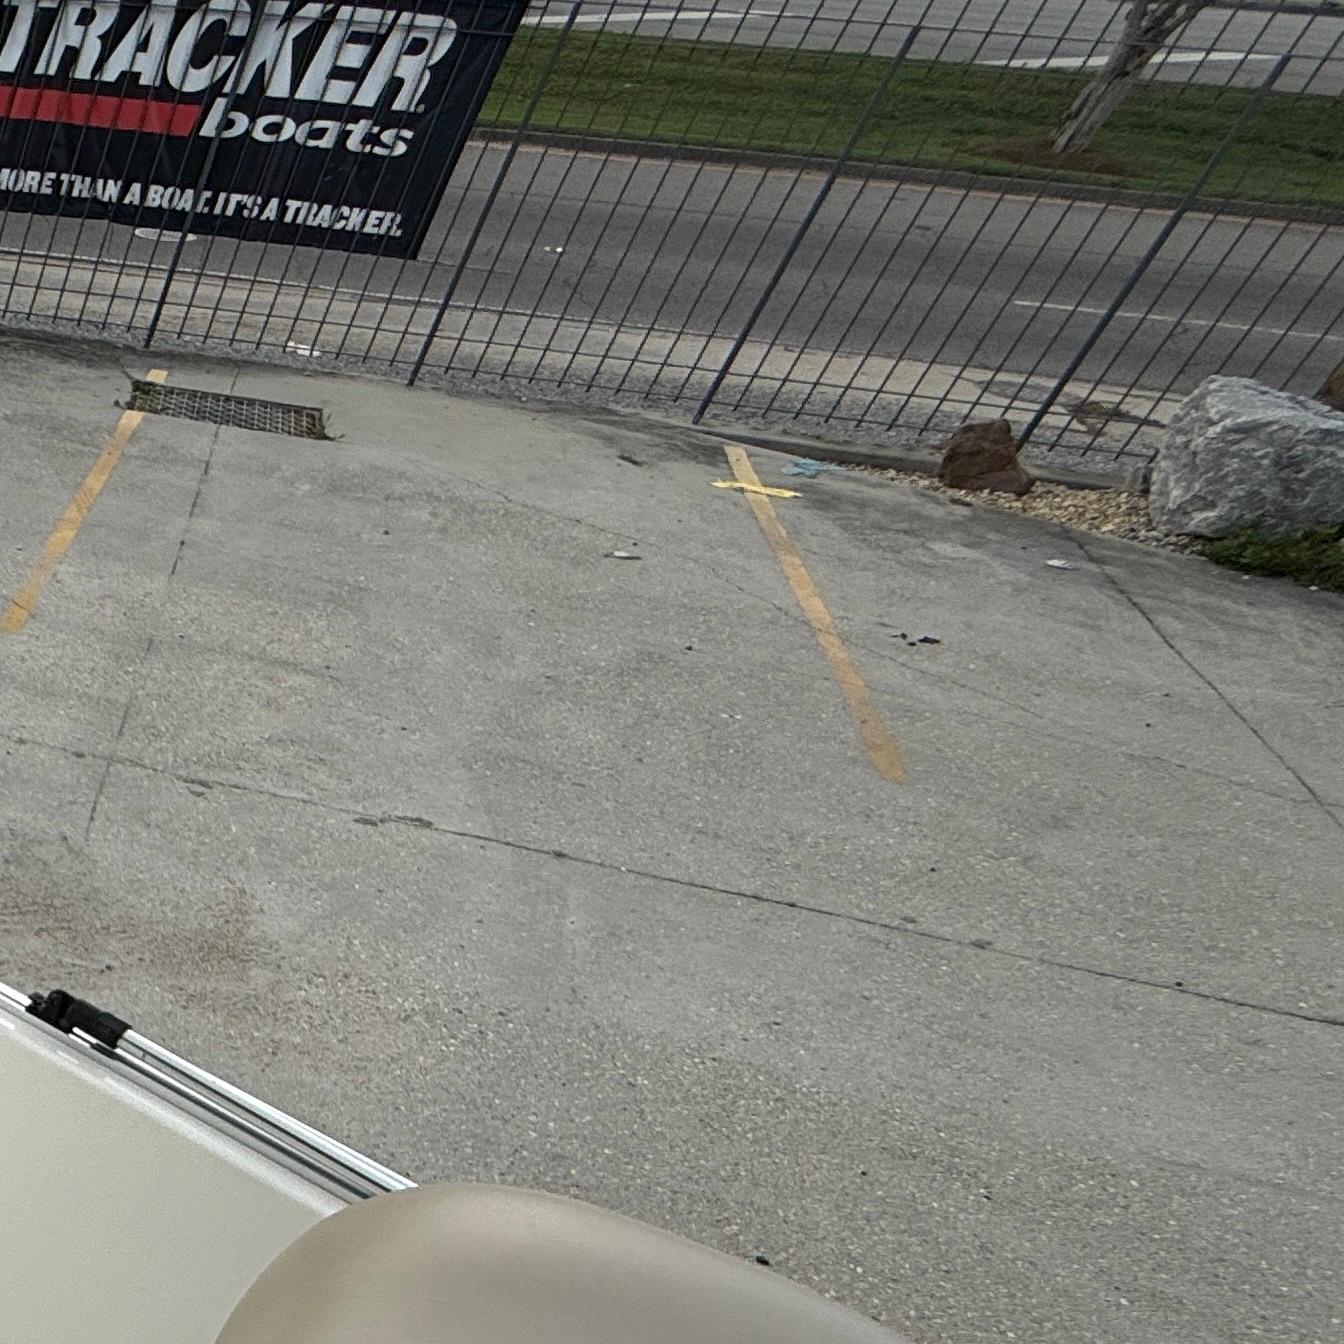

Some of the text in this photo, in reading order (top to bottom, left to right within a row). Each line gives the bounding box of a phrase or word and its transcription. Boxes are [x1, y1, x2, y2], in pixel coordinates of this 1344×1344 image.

[199, 97, 415, 156] boats
[60, 173, 122, 202] THAN
[123, 183, 142, 206] A
[213, 192, 262, 218] IT'S
[260, 198, 280, 221] A
